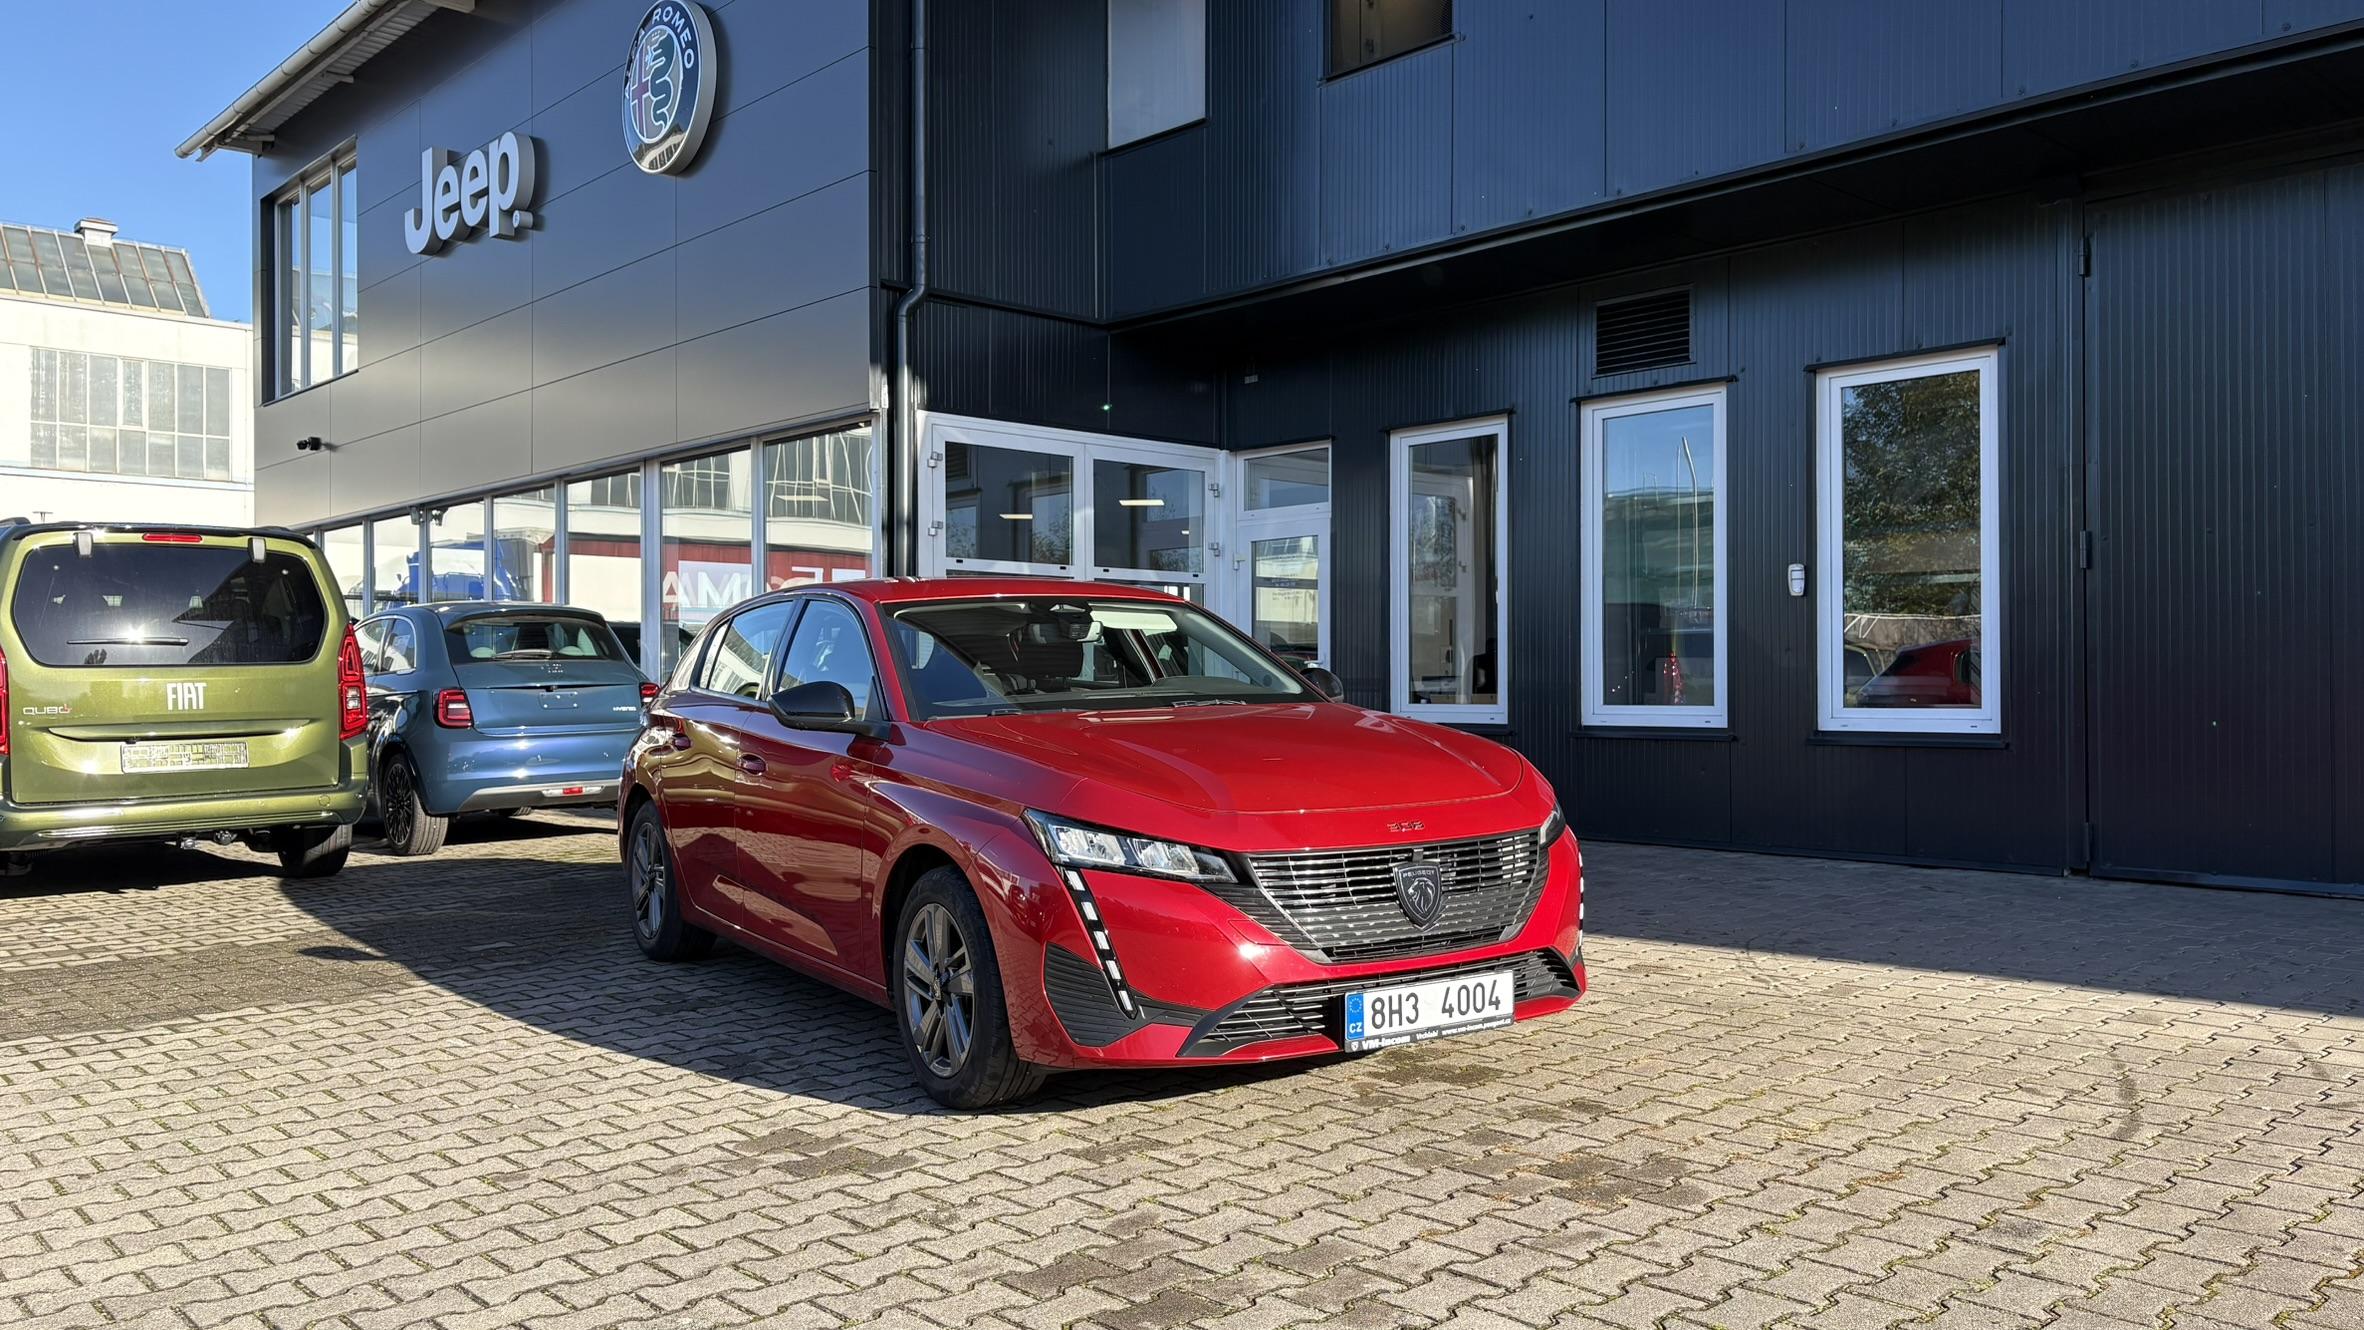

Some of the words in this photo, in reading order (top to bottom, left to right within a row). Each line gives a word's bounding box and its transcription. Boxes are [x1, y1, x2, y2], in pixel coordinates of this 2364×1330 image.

[651, 6, 695, 69] ROMEO
[167, 682, 207, 710] FIAT
[1403, 870, 1435, 878] PEUGEOT
[1371, 992, 1419, 1029] 8H3
[1441, 979, 1501, 1018] 4004
[1349, 1022, 1363, 1034] CZ
